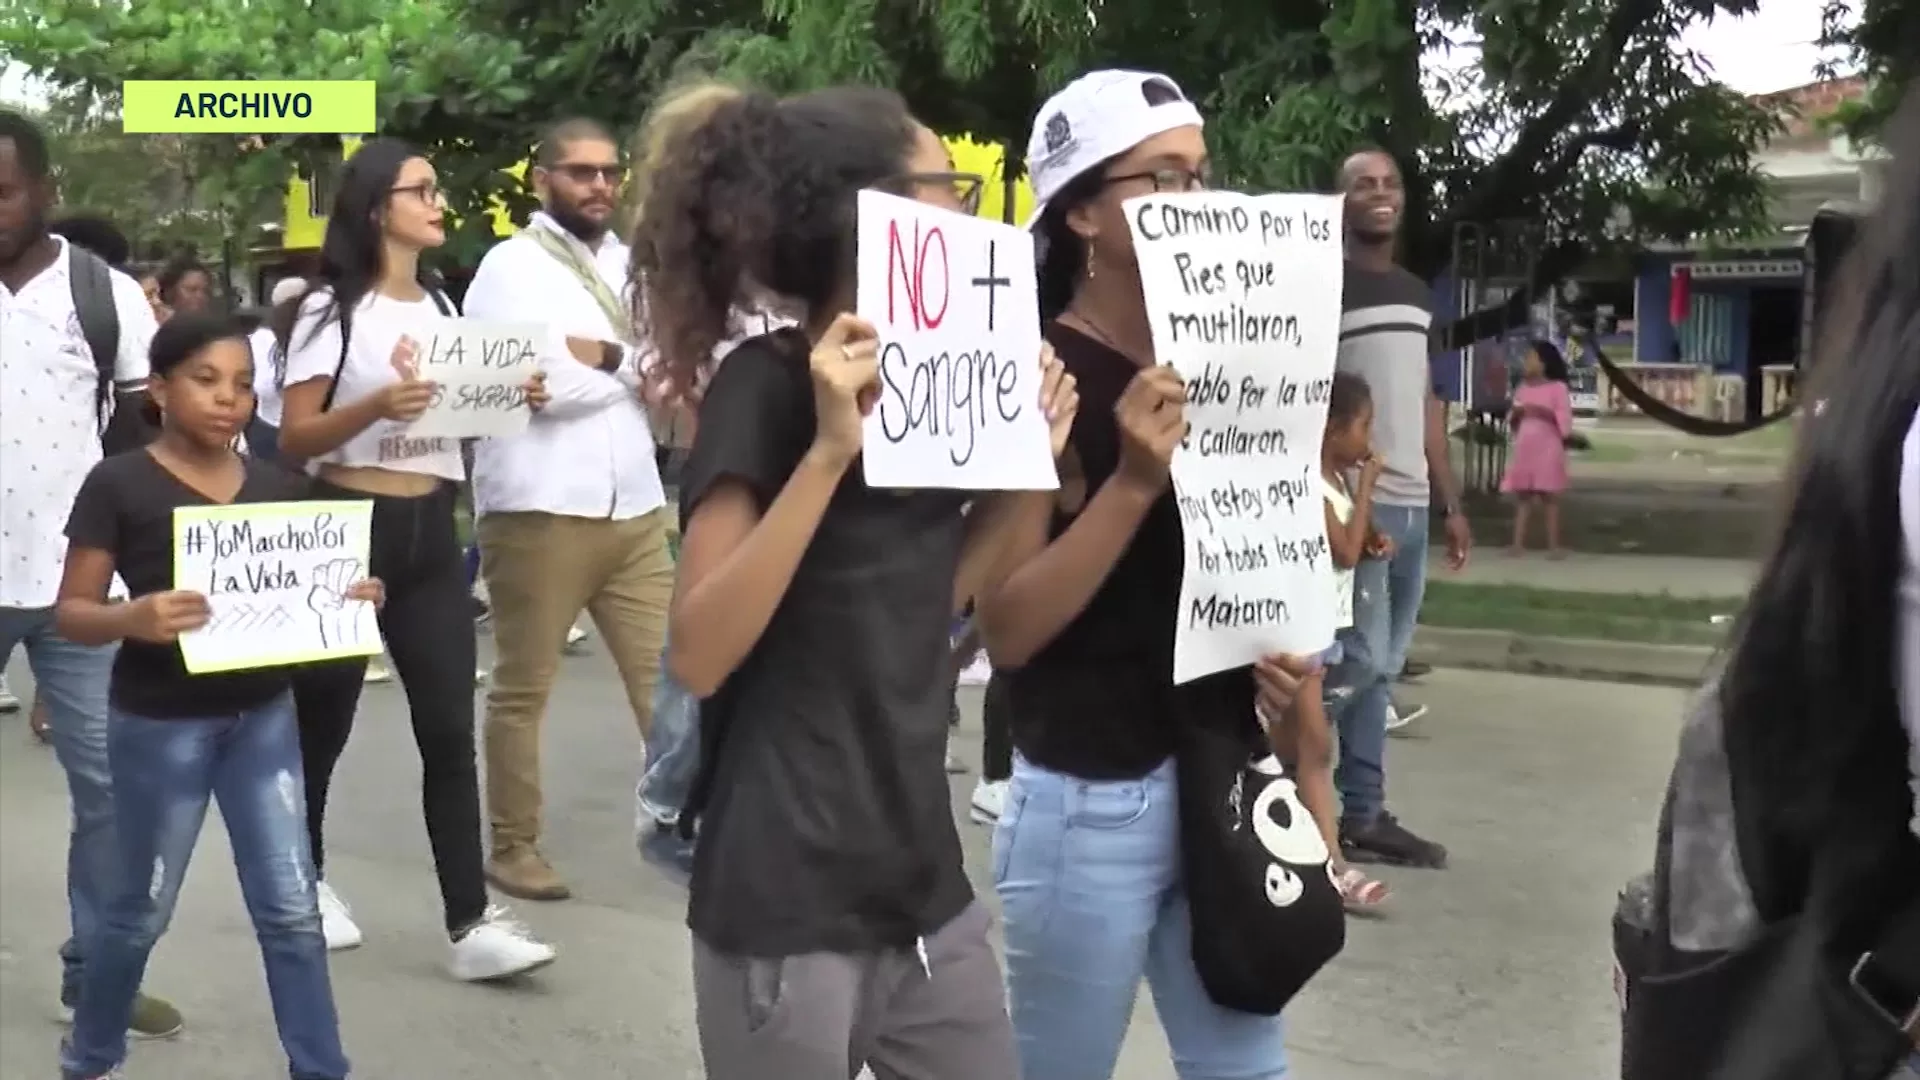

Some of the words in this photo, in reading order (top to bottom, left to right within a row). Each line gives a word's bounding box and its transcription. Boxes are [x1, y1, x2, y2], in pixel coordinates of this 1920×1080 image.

[1137, 202, 1249, 241] Camino
[1303, 208, 1330, 241] los
[888, 217, 949, 332] NO
[971, 239, 1010, 332] +
[1174, 252, 1225, 295] Pies
[1235, 259, 1276, 301] que
[1168, 302, 1302, 347] mutilaron,
[429, 334, 466, 365] LA
[482, 338, 536, 368] VIDA
[880, 342, 1022, 466] Sangre
[1166, 360, 1230, 408] ablo
[1276, 374, 1297, 408] la
[1211, 479, 1264, 521] estoy
[1268, 464, 1309, 516] aquí
[1222, 535, 1268, 575] todos
[1275, 534, 1299, 564] los
[1301, 533, 1328, 573] que
[210, 567, 244, 596] La
[245, 560, 300, 595] Vida
